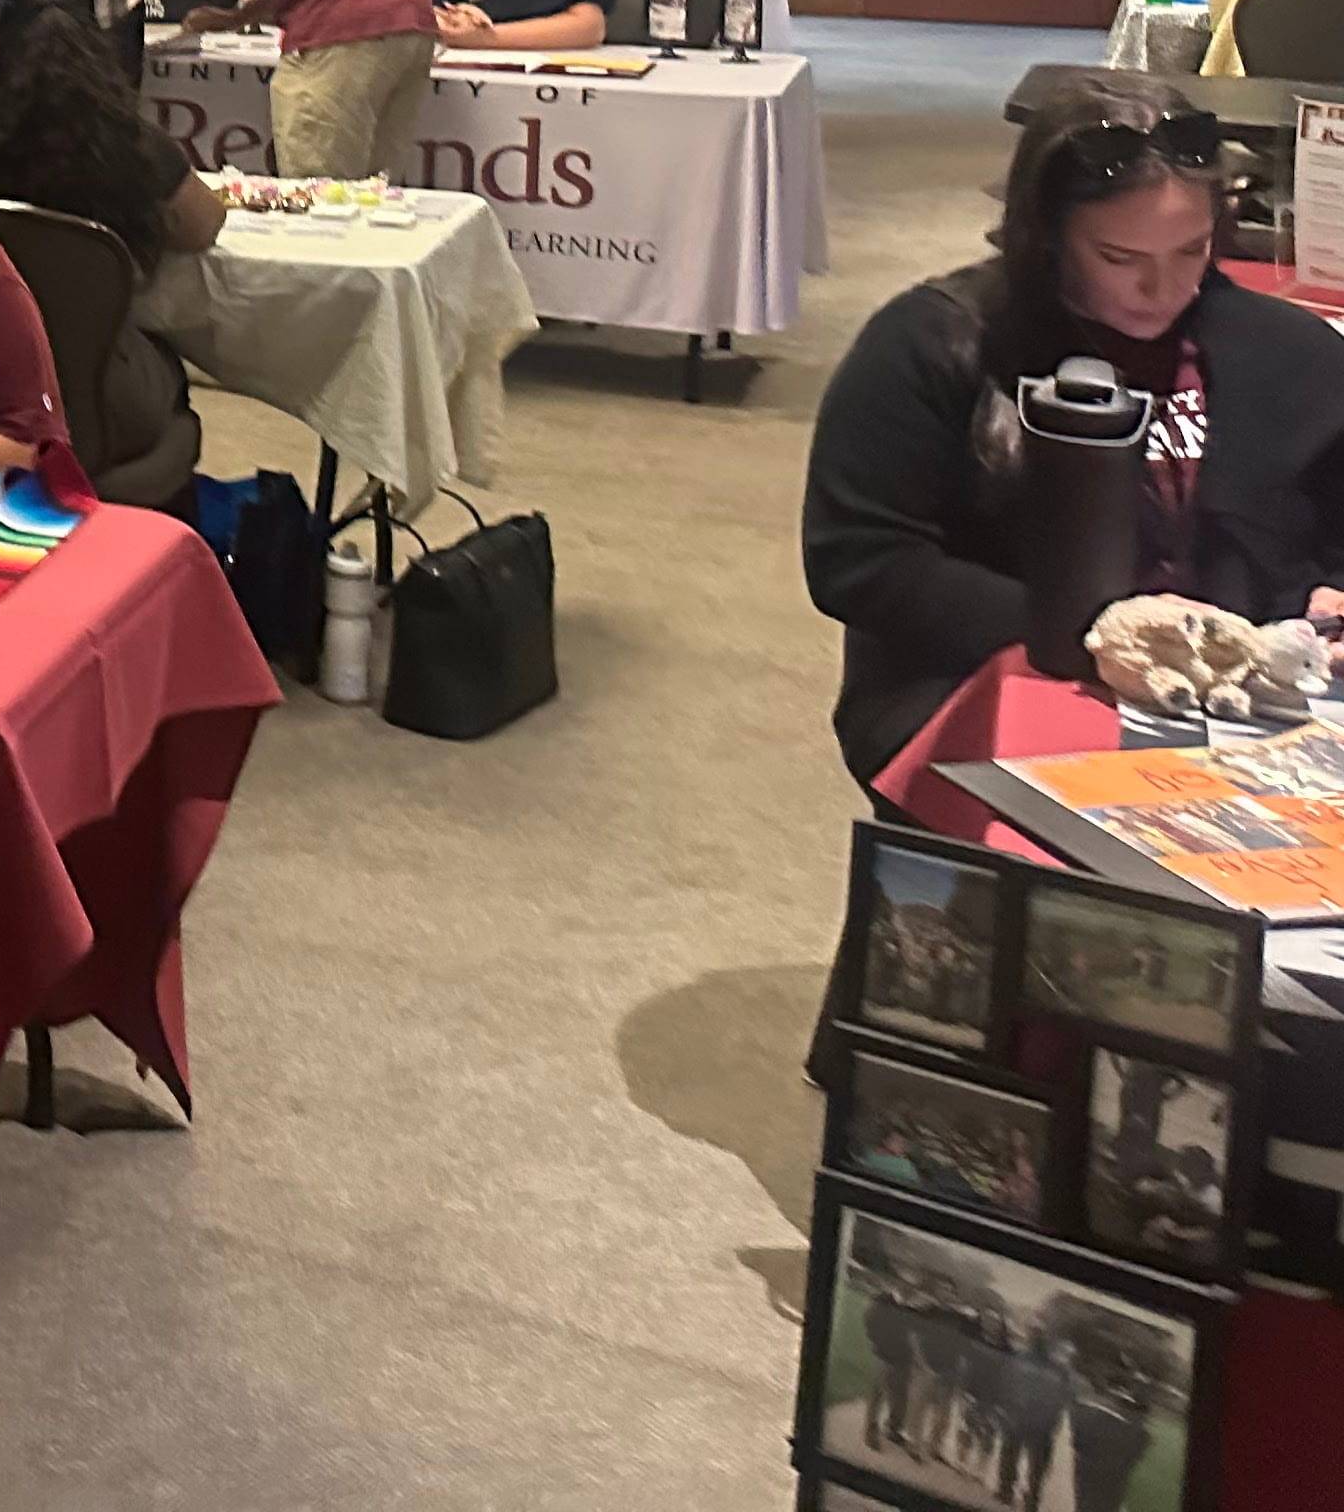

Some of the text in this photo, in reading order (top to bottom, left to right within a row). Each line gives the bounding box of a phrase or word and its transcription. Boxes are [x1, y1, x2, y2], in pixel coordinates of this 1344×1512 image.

[535, 84, 599, 106] OF
[152, 96, 594, 209] Rends
[508, 229, 657, 265] EARNING
